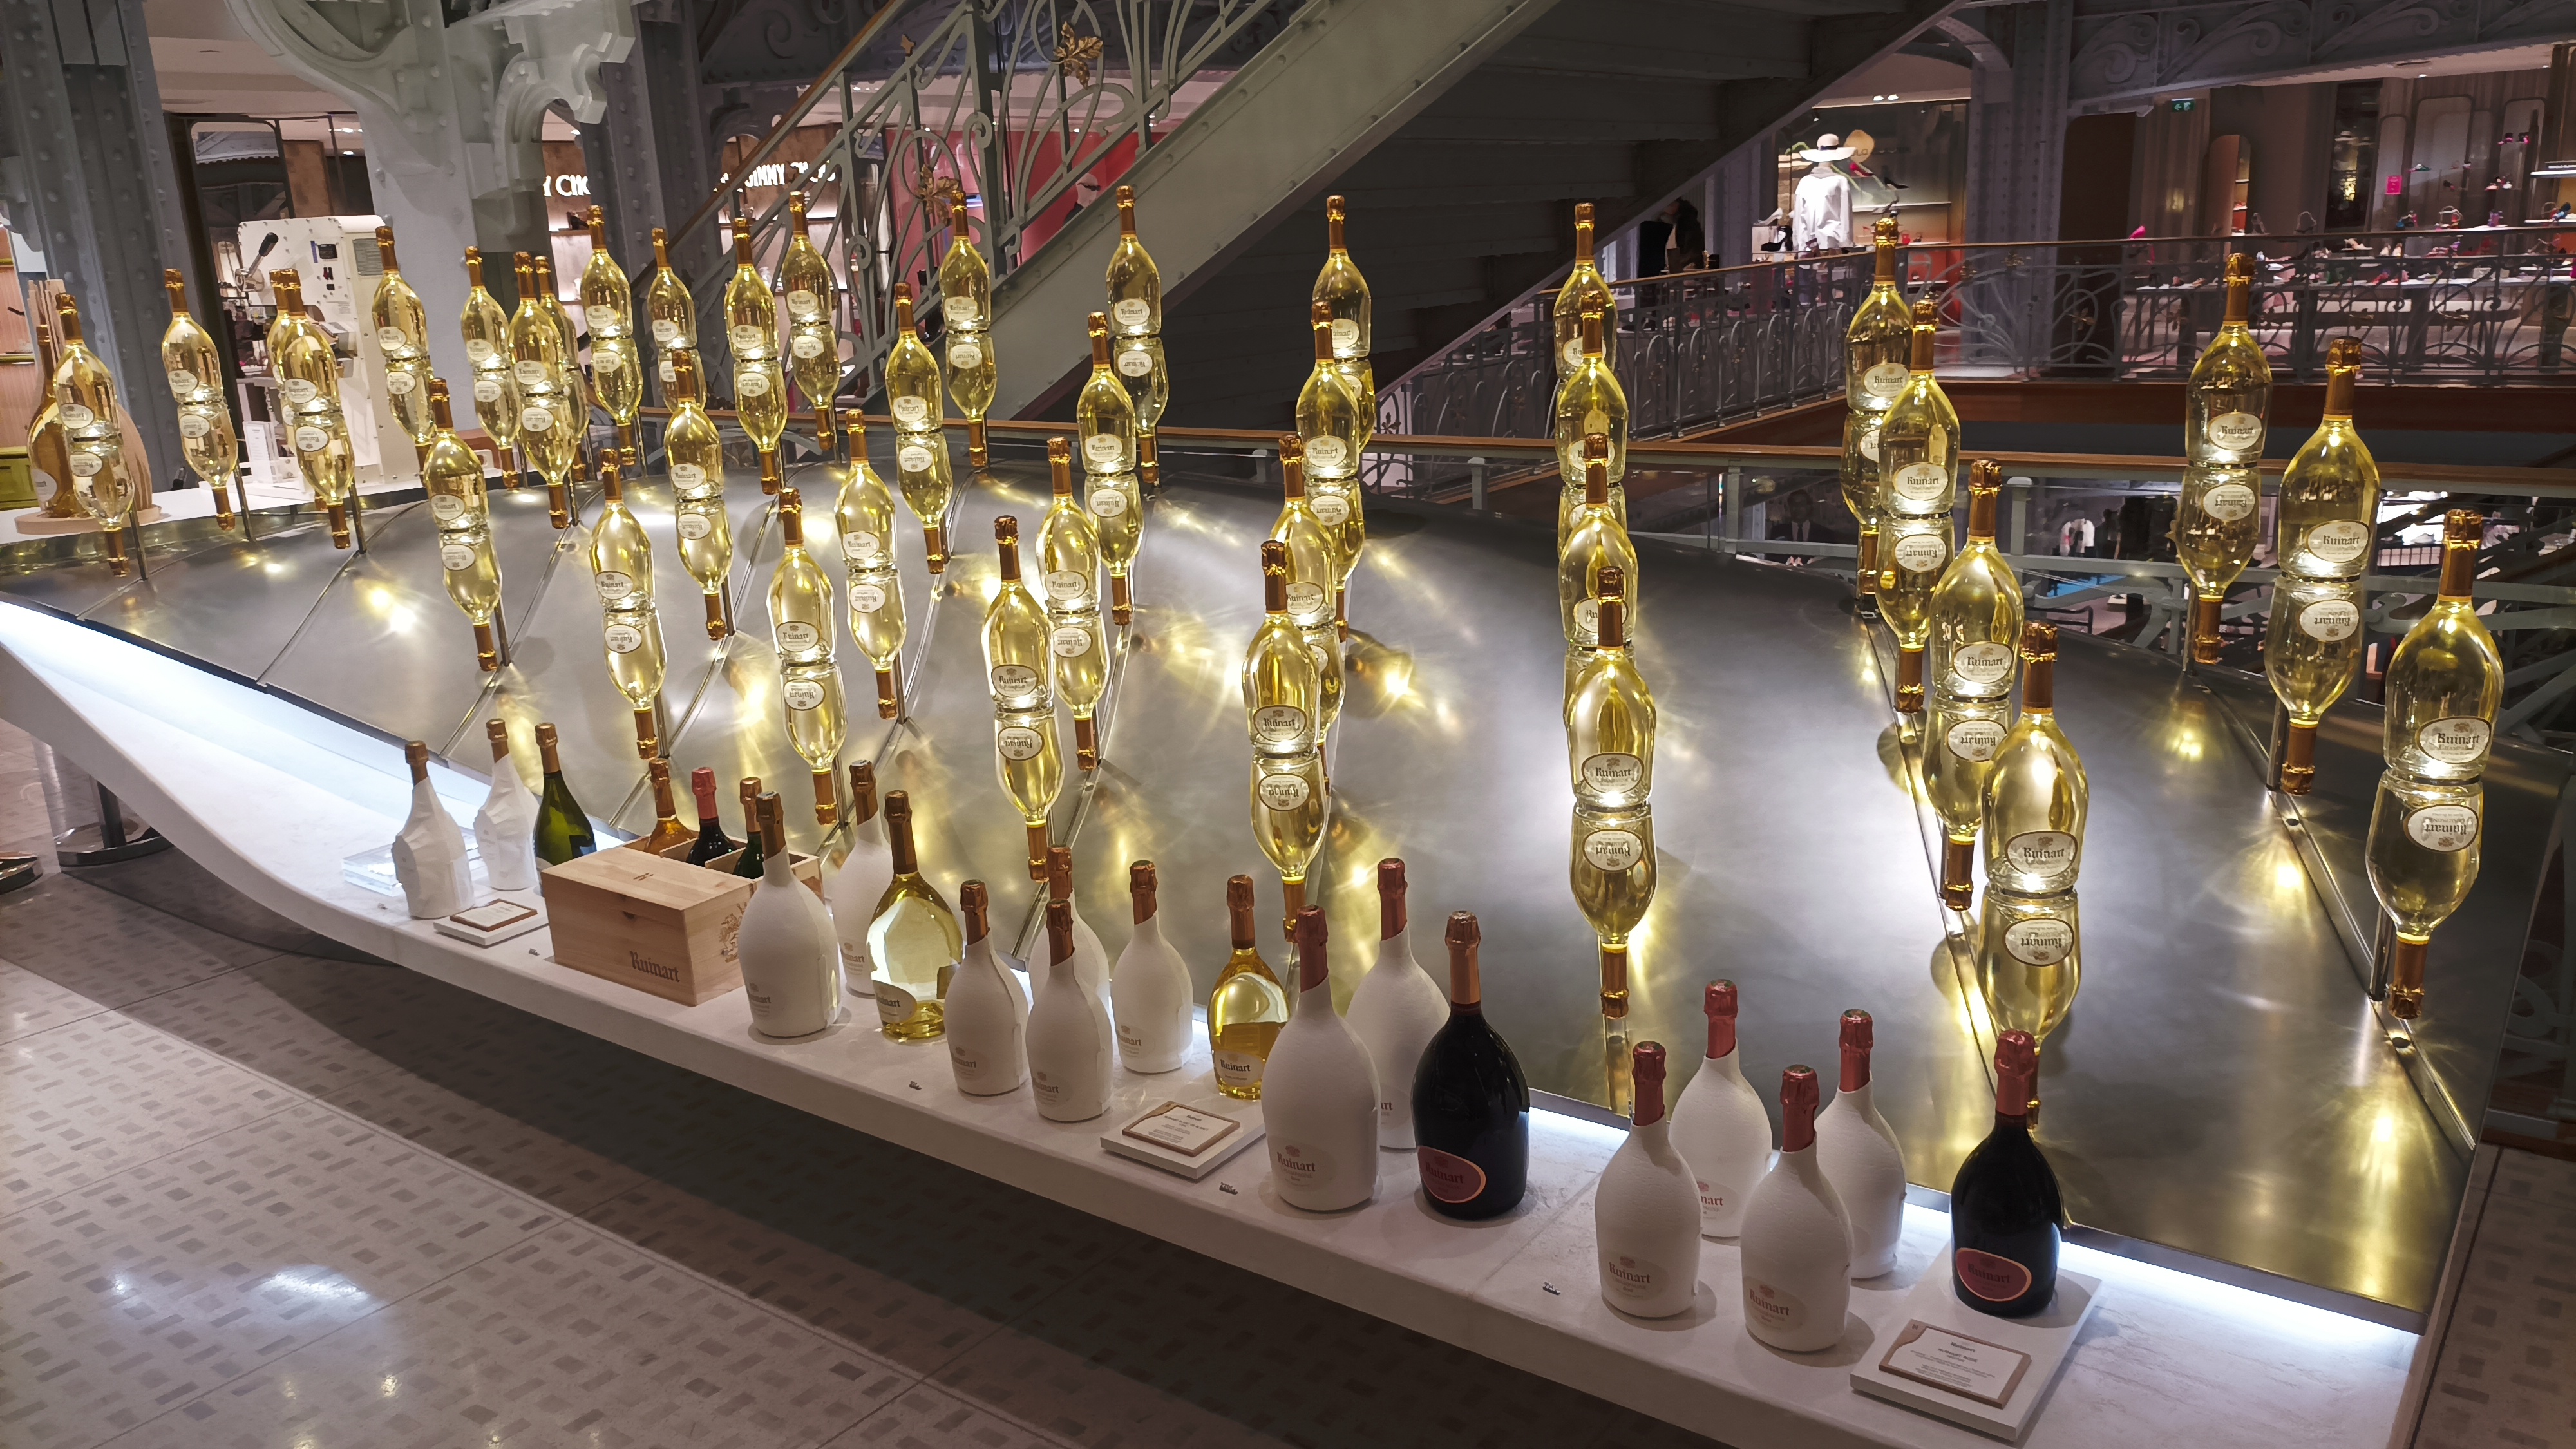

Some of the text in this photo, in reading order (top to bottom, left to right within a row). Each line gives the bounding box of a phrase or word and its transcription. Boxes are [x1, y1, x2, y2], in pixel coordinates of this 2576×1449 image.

[1874, 375, 1903, 385] Ruinart
[2221, 424, 2255, 435] Ruinart
[1906, 476, 1939, 486] Ruinart
[2215, 498, 2248, 509] Ruinart
[2322, 533, 2360, 545] Ruinart
[1906, 549, 1937, 559] Ruinart
[2315, 614, 2351, 627] Ruinart
[1967, 656, 2003, 667] Ruinart
[999, 674, 1027, 685] Ruinart
[1264, 717, 1295, 727] Ruinart
[1960, 735, 1996, 747] Ruinart
[2437, 732, 2480, 745] Ruinart
[1595, 766, 1632, 778] Ruinart
[2425, 823, 2467, 835] Ruinart
[1596, 846, 1631, 857] Ruinart
[2023, 846, 2065, 859] Ruinart
[2021, 936, 2063, 950] Ruinart
[630, 950, 681, 983] Ruinart
[1220, 1059, 1251, 1072] Ruinart
[1276, 1151, 1316, 1172] Ruinart
[1425, 1161, 1464, 1184] Ruinart
[1701, 1195, 1724, 1206] nart
[1609, 1261, 1651, 1283] Ruinart
[1967, 1262, 2011, 1283] Ruinart
[1749, 1288, 1790, 1316] Ruinart
